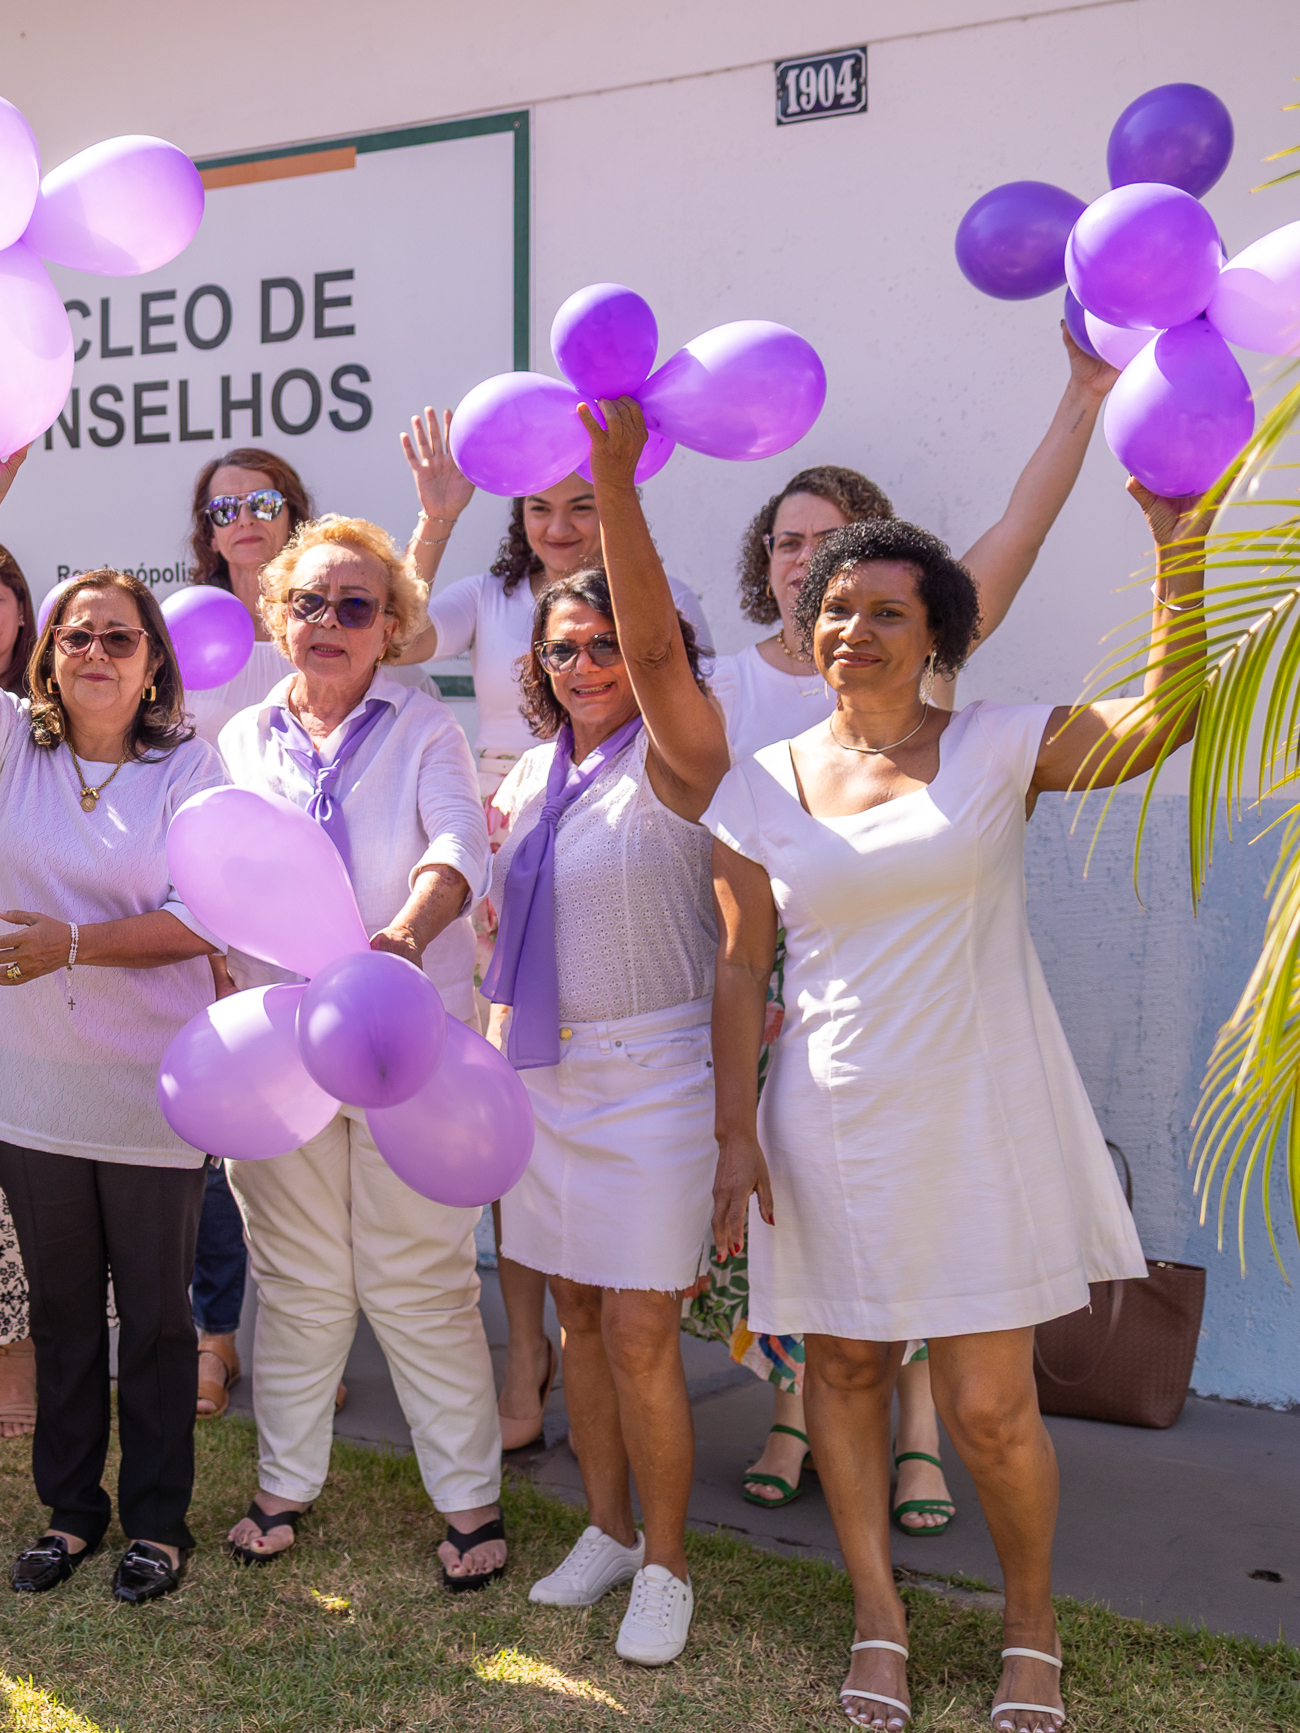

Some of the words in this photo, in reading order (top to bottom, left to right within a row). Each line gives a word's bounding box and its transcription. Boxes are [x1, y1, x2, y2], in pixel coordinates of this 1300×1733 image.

[786, 59, 857, 114] 1904
[65, 283, 232, 362] CLEO
[260, 269, 355, 343] DE
[44, 363, 372, 450] NSELHOS
[57, 562, 196, 588] Rnópolis
